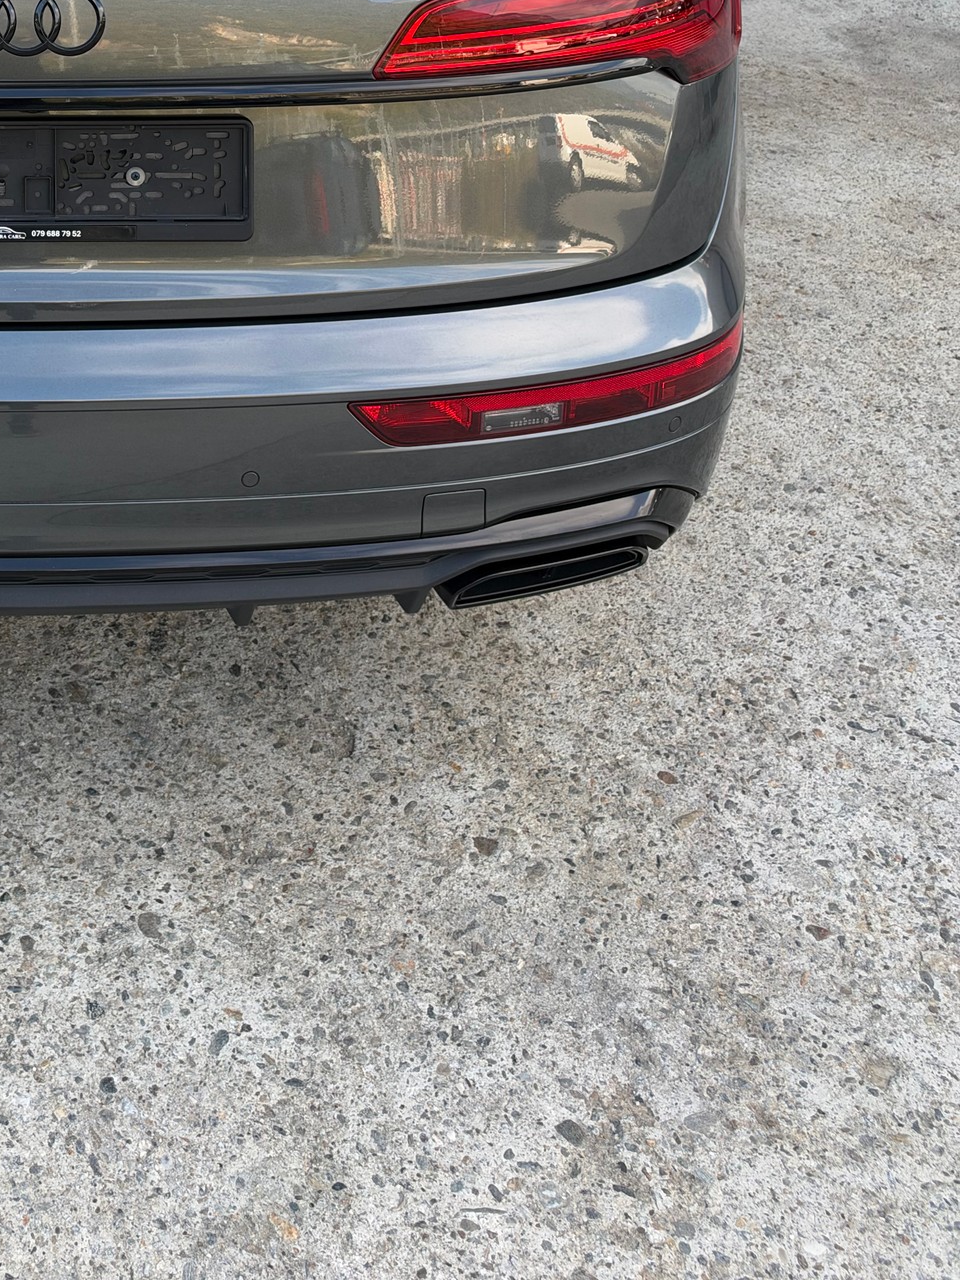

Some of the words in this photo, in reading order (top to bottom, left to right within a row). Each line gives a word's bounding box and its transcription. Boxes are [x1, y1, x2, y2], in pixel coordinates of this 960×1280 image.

[31, 230, 45, 238] 079
[46, 230, 60, 238] 688
[61, 230, 71, 238] 79
[72, 230, 82, 238] 52
